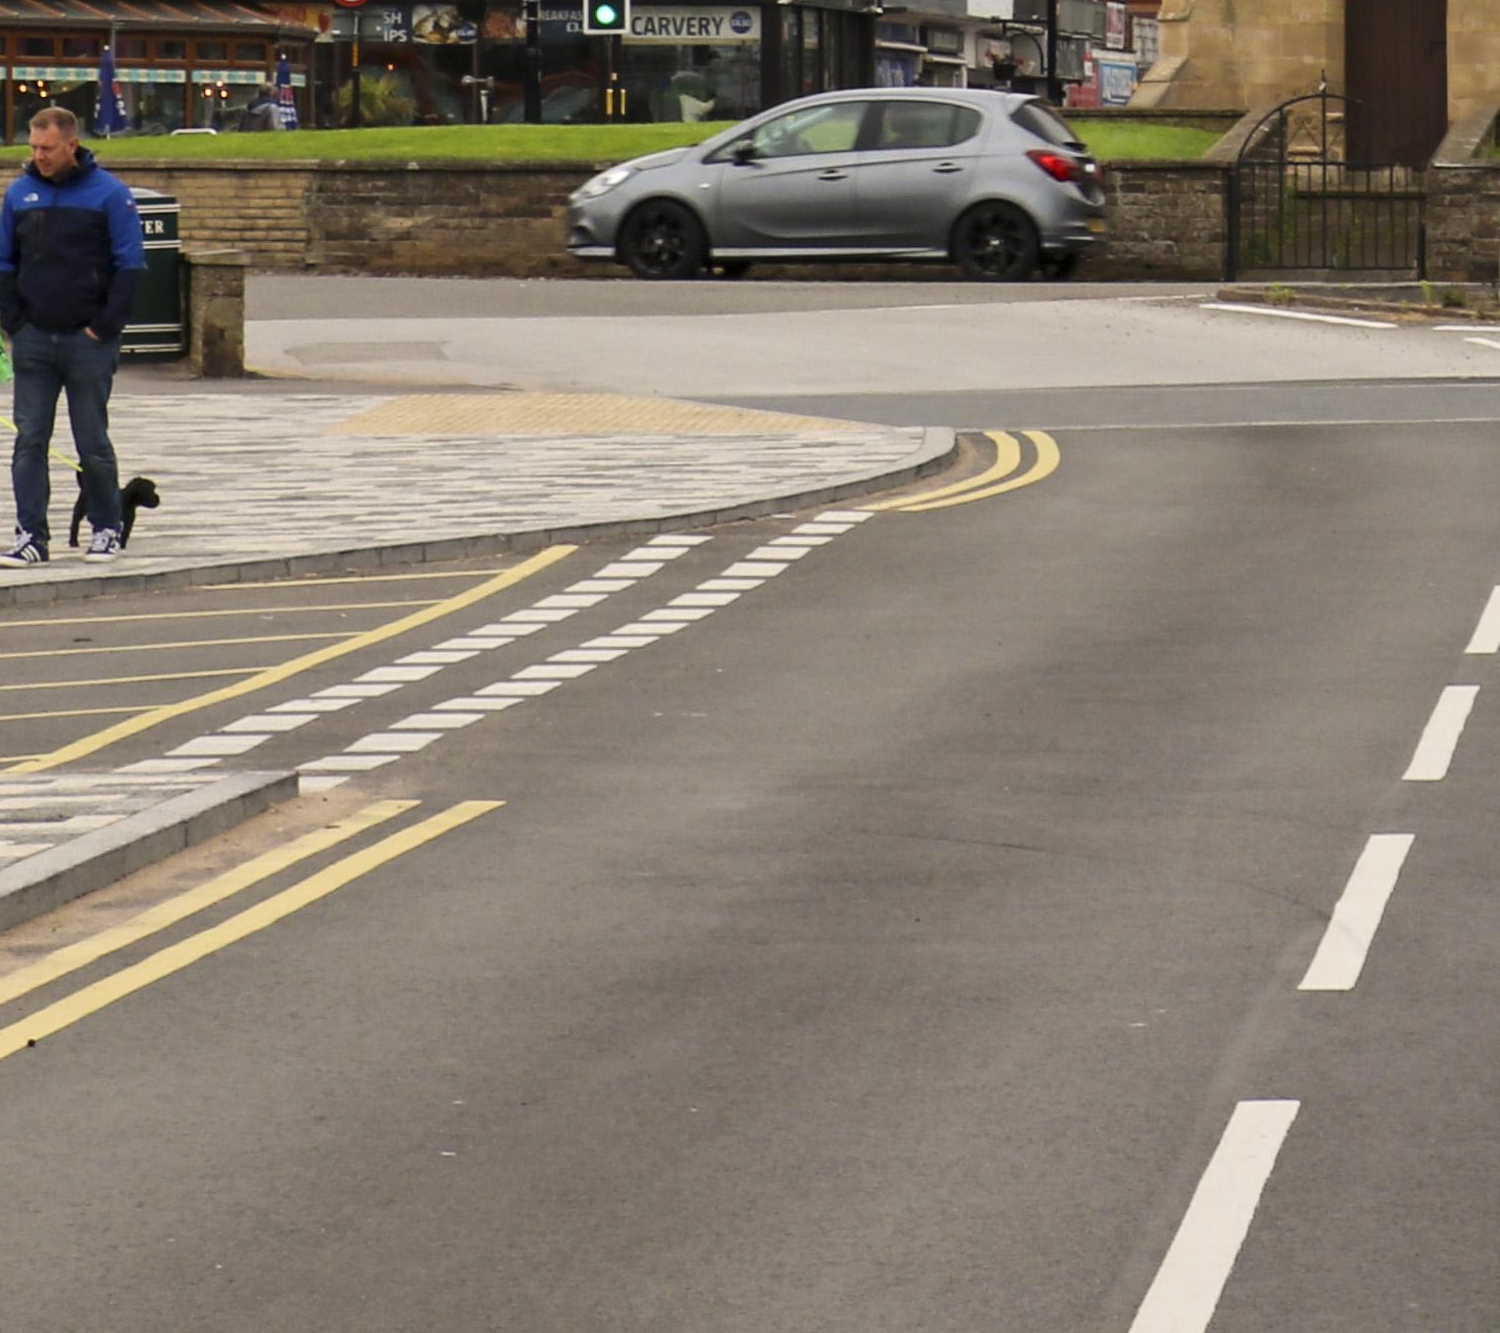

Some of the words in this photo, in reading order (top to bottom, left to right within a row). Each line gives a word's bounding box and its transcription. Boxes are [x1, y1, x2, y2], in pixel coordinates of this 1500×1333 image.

[383, 10, 403, 25] SH
[631, 16, 725, 37] CARVERY
[383, 28, 408, 43] IPS
